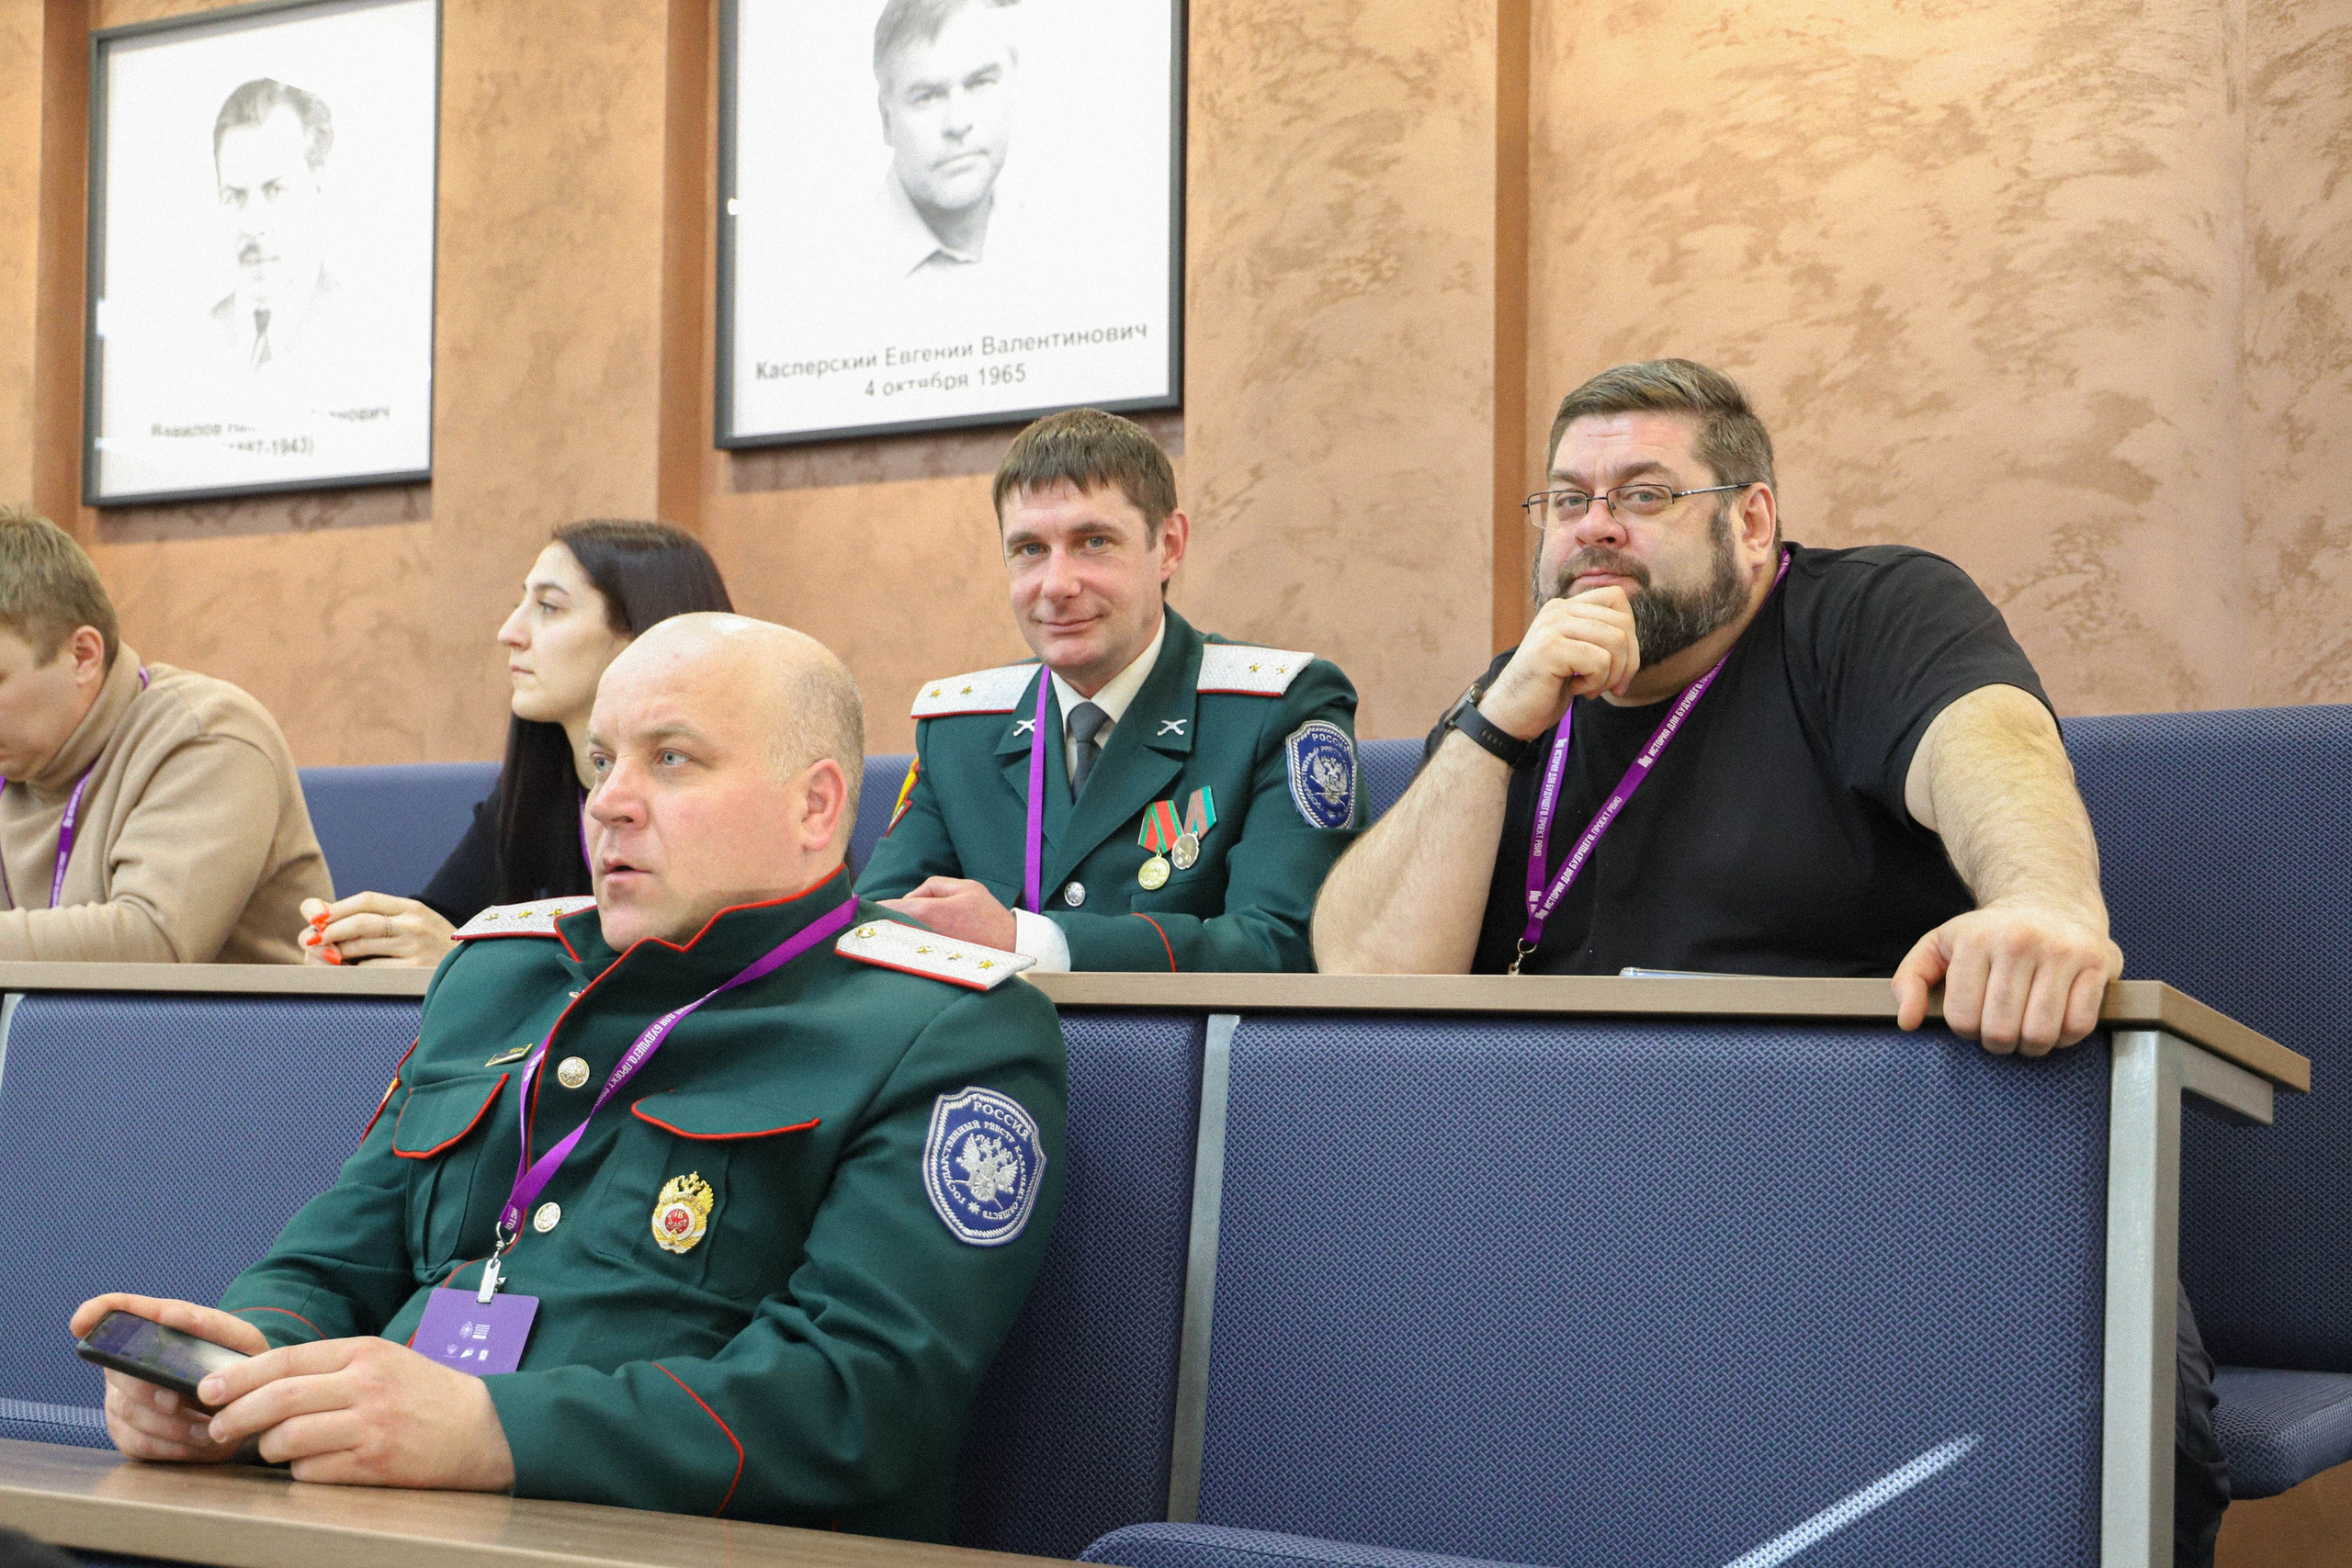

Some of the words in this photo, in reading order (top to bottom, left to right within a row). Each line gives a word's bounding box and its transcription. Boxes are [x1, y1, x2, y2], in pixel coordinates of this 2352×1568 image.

[981, 323, 1148, 355] Валентинович
[865, 379, 876, 396] 4
[882, 371, 969, 396] октября
[978, 363, 1026, 386] 1965
[1312, 733, 1348, 752] РОССИЯ
[1647, 728, 1671, 757] ИСТОРИЯ
[1667, 715, 1680, 731] ДЛЯ
[1547, 772, 1557, 784] ДЛЯ
[1535, 817, 1547, 838] ПРОЕКТ
[1533, 839, 1544, 857] РВИО
[1544, 881, 1566, 909] ИСТОРИЯ
[1560, 866, 1575, 885] ДЛЯ
[1590, 811, 1611, 835] ПРОЕКТ
[1606, 795, 1623, 814] РВИО
[608, 1062, 633, 1089] ПРОЕКТ
[973, 1101, 1031, 1142] РОССИЯ
[983, 1121, 1016, 1143] РЕЕСТР
[941, 1120, 980, 1205] ГОСУДАРСТВЕННЫЙ
[504, 1207, 518, 1231] ИСТО
[982, 1201, 1019, 1220] ОБЩЕСТВ
